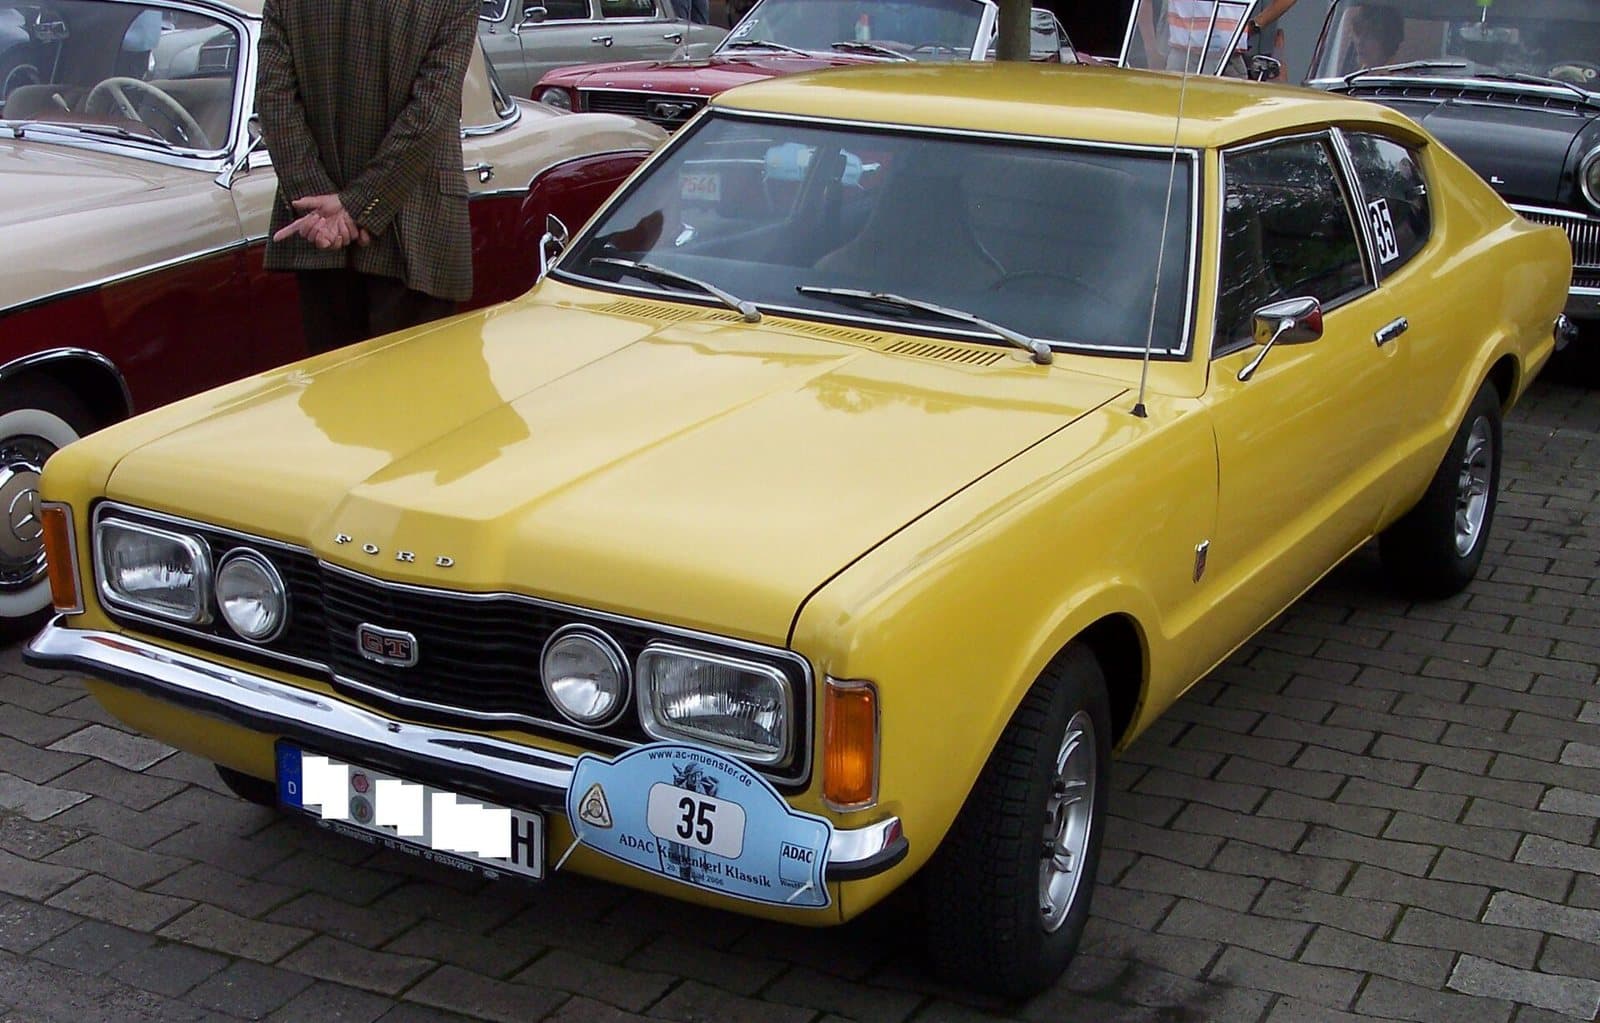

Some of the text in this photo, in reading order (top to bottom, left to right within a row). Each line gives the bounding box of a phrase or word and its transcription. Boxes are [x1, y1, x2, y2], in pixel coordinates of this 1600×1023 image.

[1369, 202, 1396, 259] 35
[335, 533, 455, 567] FORD
[363, 632, 409, 658] GT
[648, 751, 752, 787] www.ac-muenster.de
[287, 781, 297, 794] D
[676, 797, 716, 845] 35
[511, 816, 534, 868] H
[782, 845, 813, 864] ADAC
[619, 833, 655, 854] ADAC
[725, 861, 771, 888] Klassik
